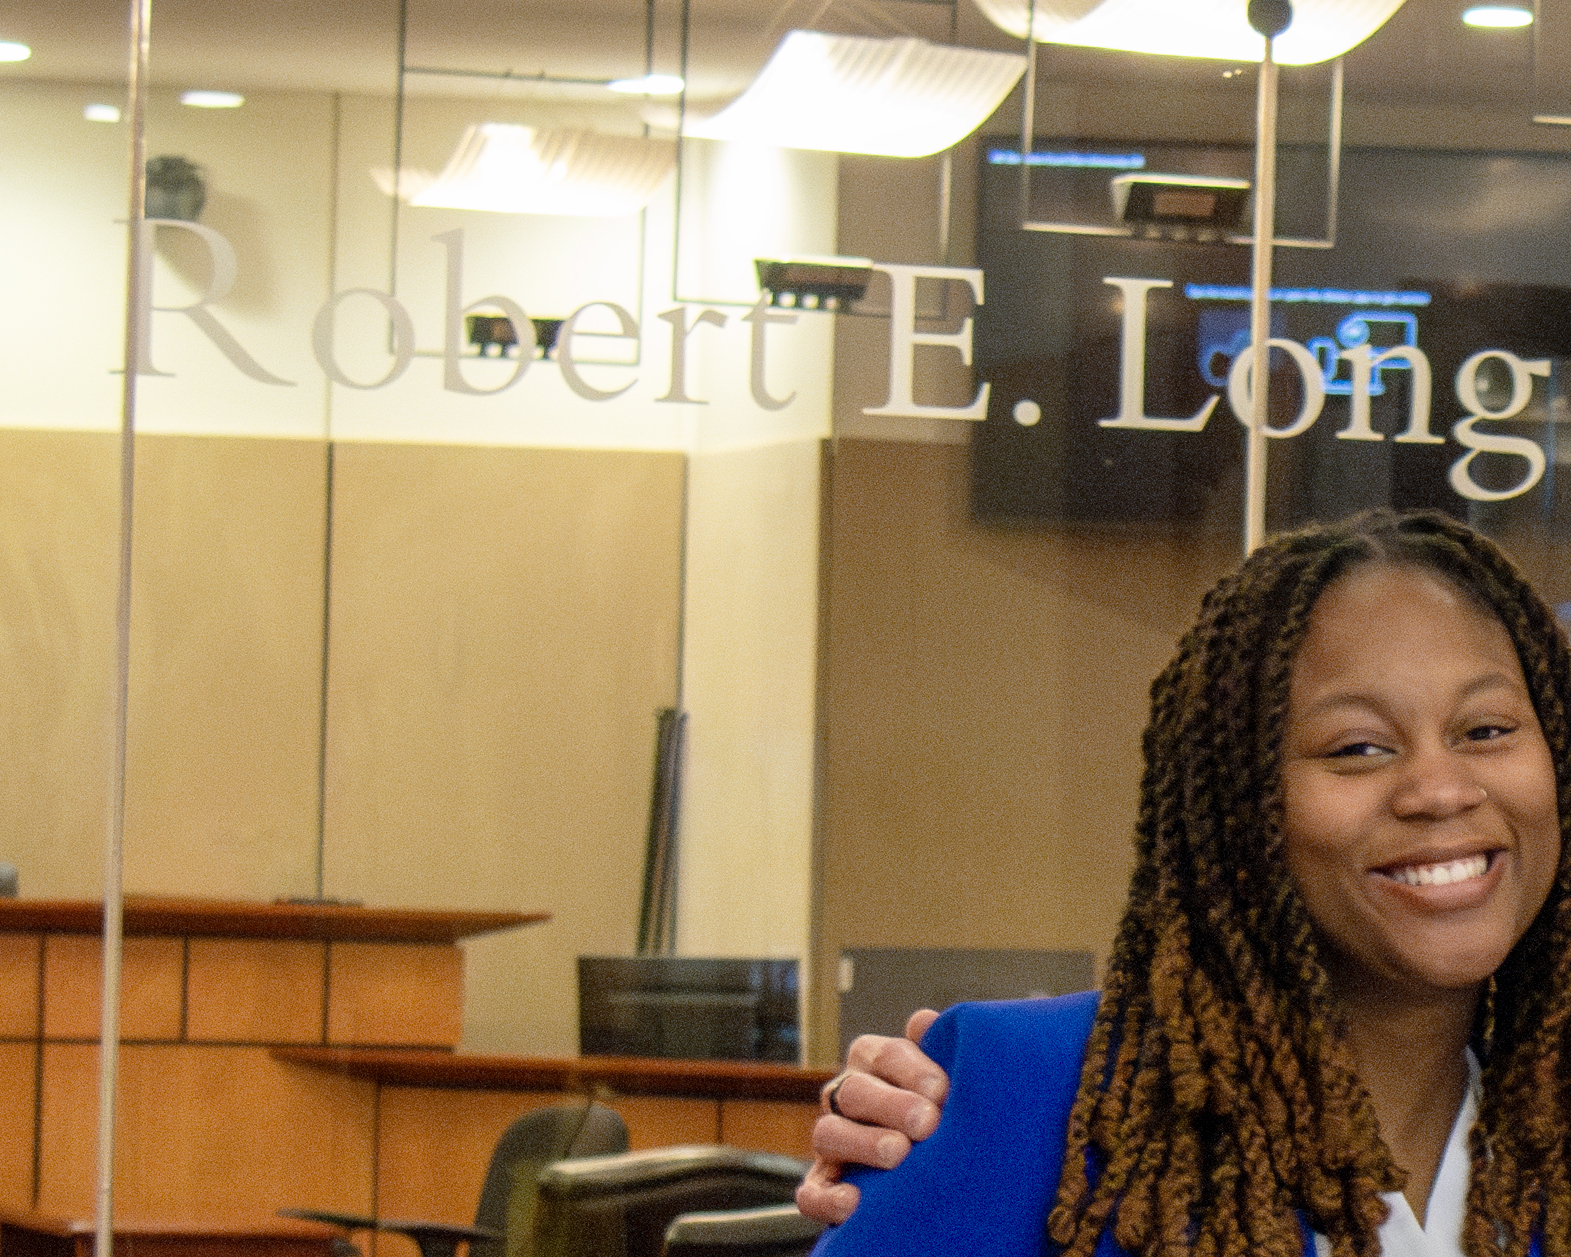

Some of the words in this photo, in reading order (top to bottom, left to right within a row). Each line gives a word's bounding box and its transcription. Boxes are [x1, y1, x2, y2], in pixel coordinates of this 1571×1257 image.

[108, 216, 800, 412] Robert
[861, 264, 1042, 427] E.
[1098, 276, 1552, 503] Long
